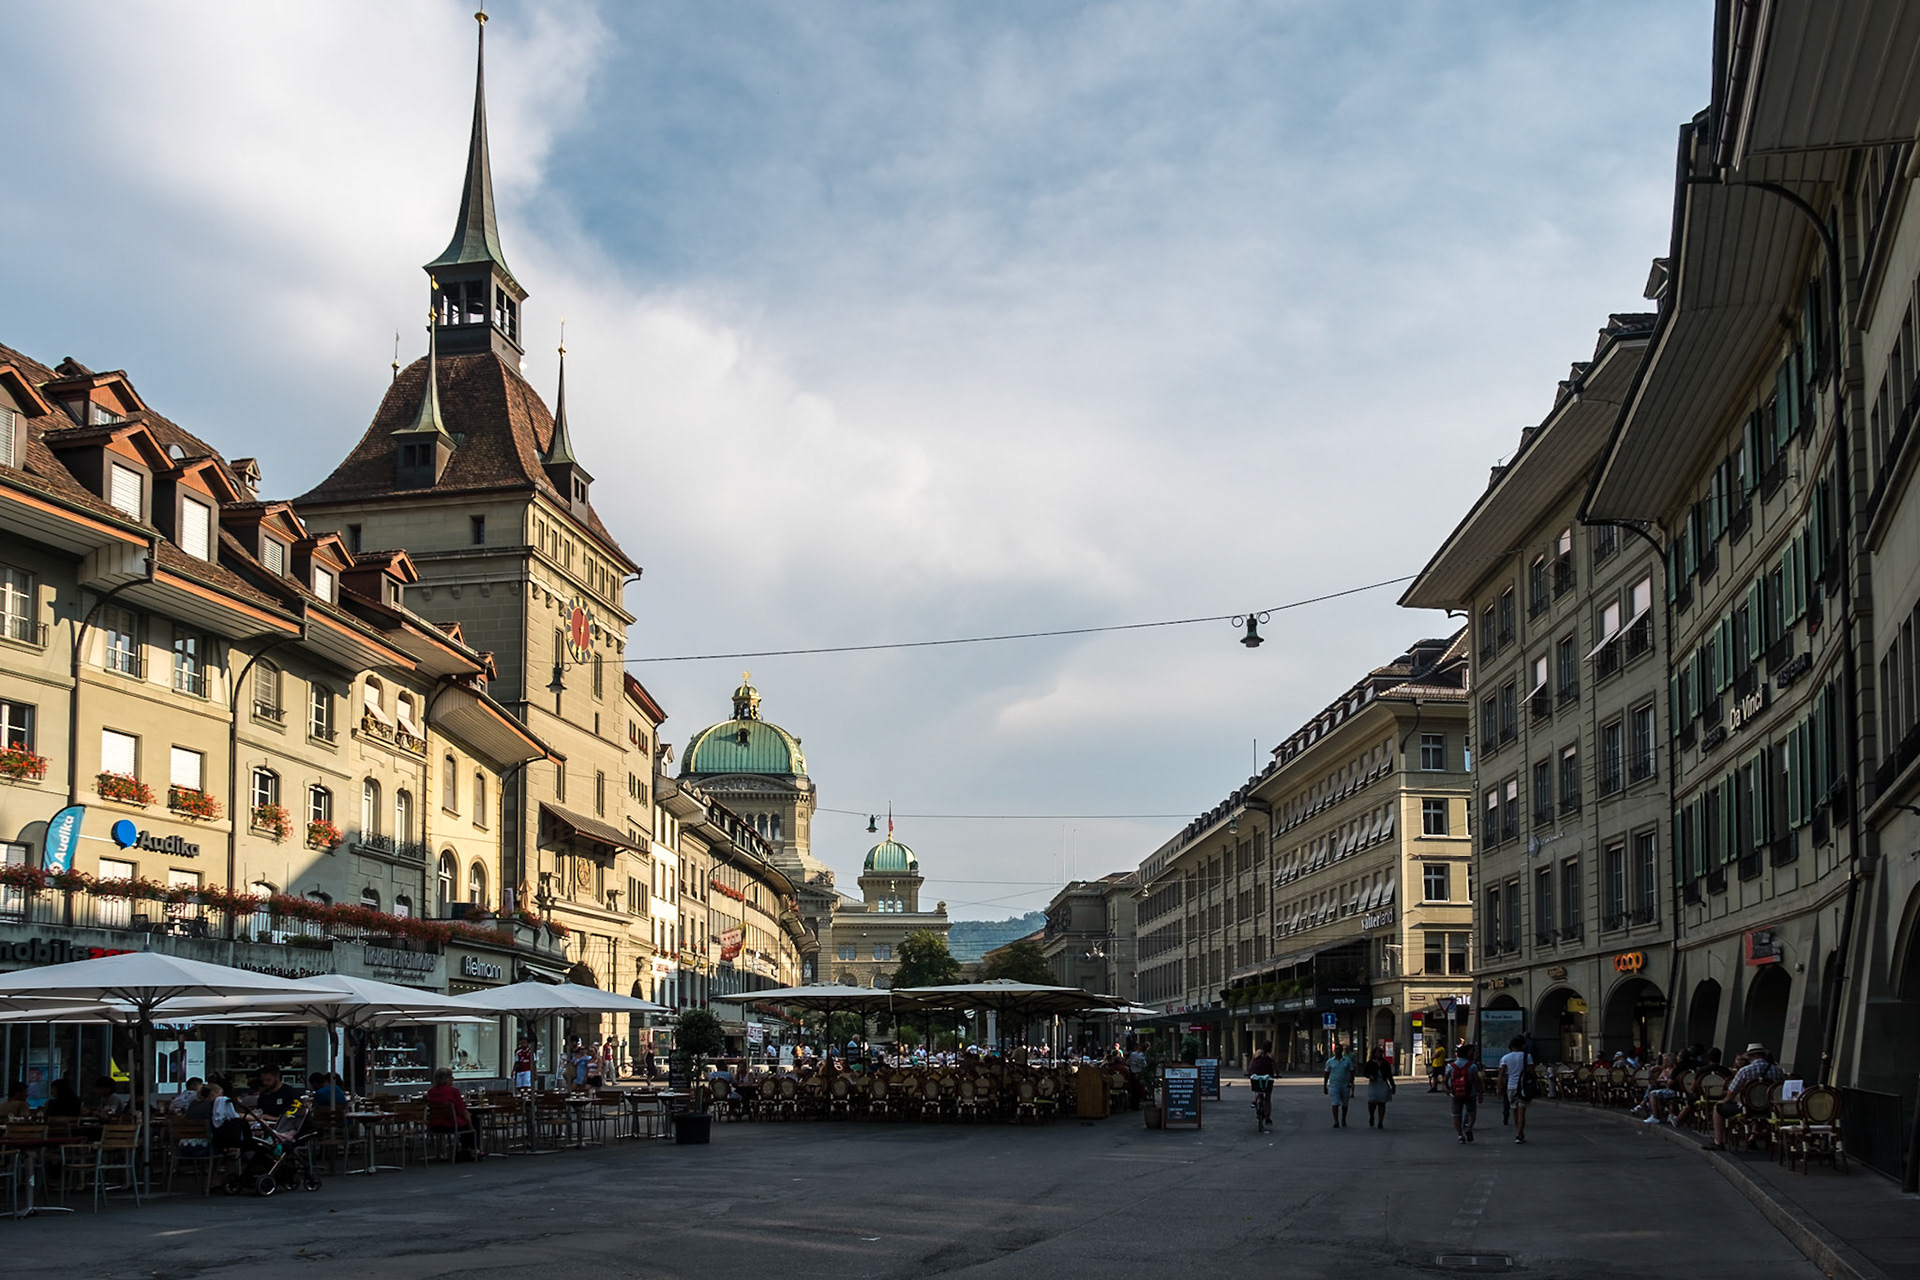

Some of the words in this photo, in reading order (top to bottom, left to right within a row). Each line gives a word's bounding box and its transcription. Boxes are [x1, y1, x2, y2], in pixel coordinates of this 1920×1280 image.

[1730, 707, 1741, 731] Da
[1742, 684, 1764, 721] Vinci
[54, 815, 75, 862] Audika
[138, 831, 200, 857] Audika
[465, 955, 503, 979] fielmann
[1613, 951, 1643, 974] coop
